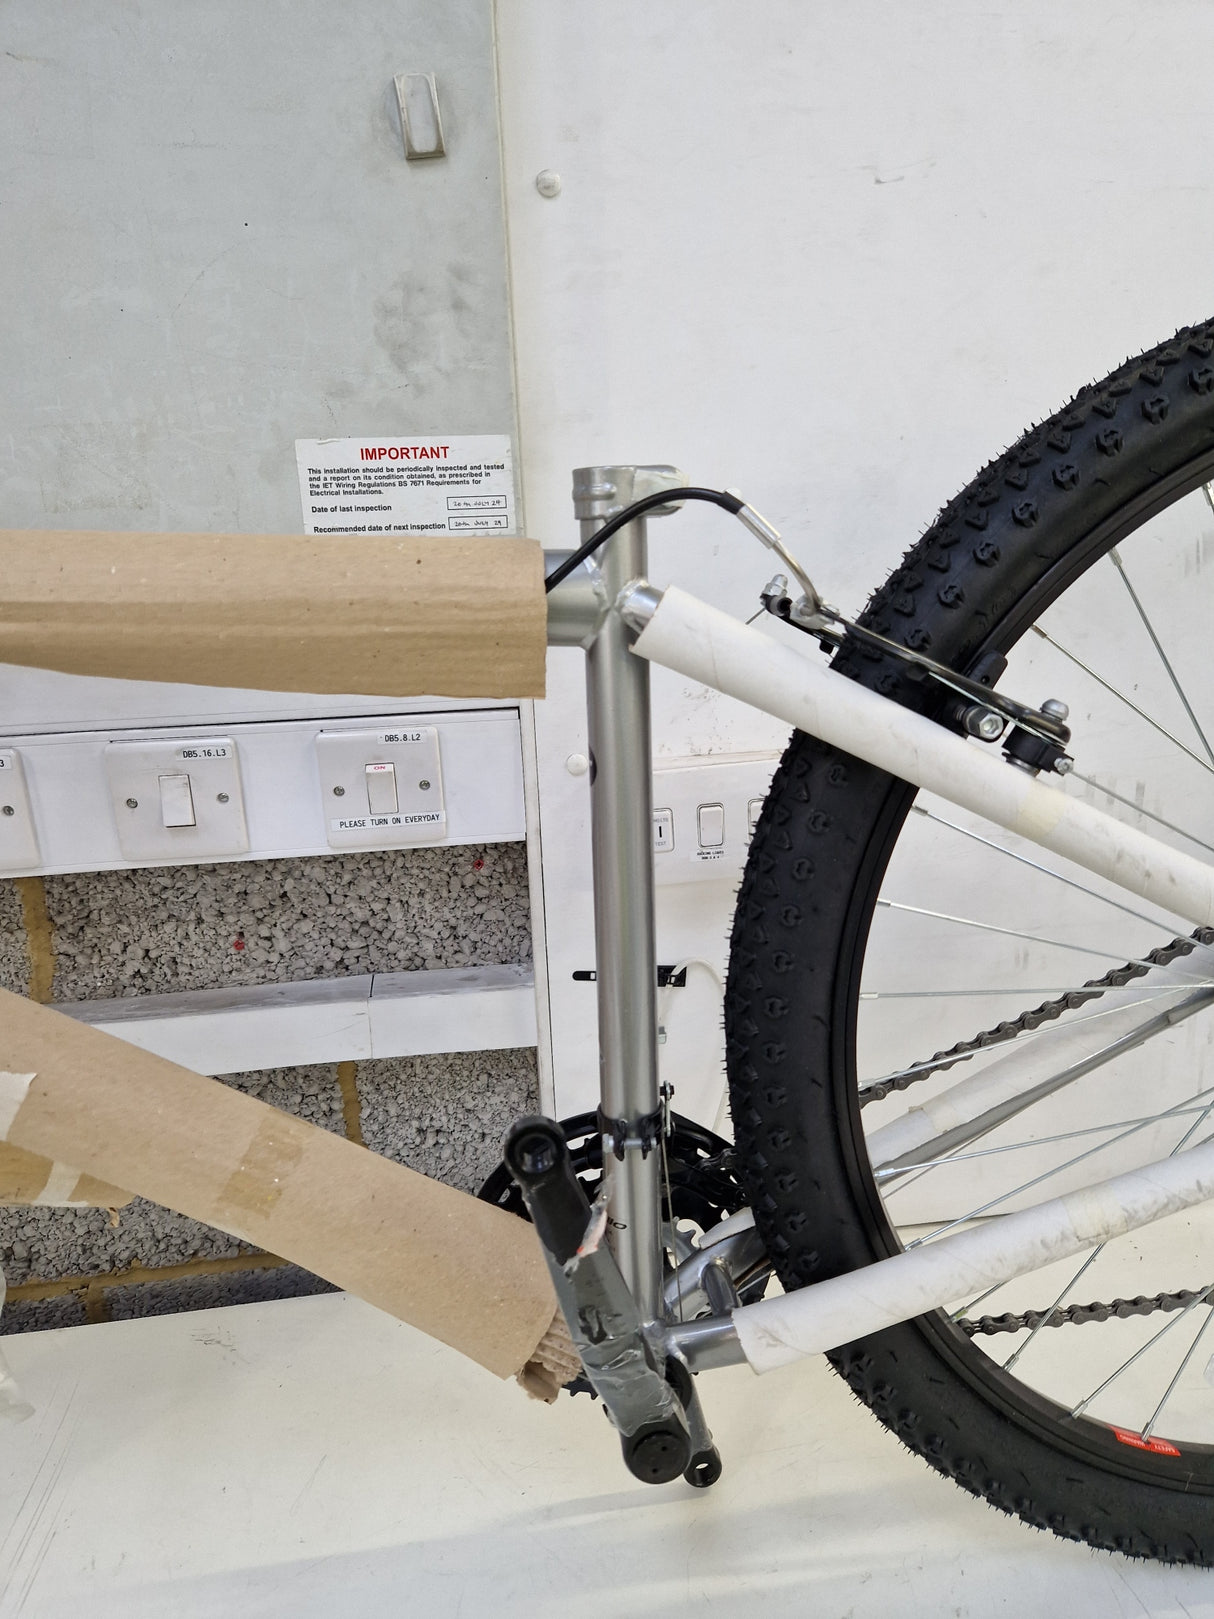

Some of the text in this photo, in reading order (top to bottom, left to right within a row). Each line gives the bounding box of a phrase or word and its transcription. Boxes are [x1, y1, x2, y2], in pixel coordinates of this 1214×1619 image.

[360, 446, 449, 460] IMPORTANT
[362, 466, 384, 474] should
[396, 465, 434, 473] periodically
[435, 464, 468, 472] inspected
[330, 475, 350, 483] report
[448, 471, 483, 480] prescribed
[335, 482, 356, 490] Wiring
[358, 481, 396, 489] Regulations
[426, 479, 470, 487] Requirements
[309, 488, 384, 497] Electrical Installations.
[354, 504, 392, 513] inspection
[313, 525, 367, 533] Recommended
[367, 524, 383, 532] date
[393, 523, 409, 531] next
[410, 522, 446, 532] inspection
[384, 733, 421, 743] DB5.8.L2
[182, 748, 227, 759] DB5.16.L3
[340, 813, 440, 829] PLEASE TURN ON EVERYDAY
